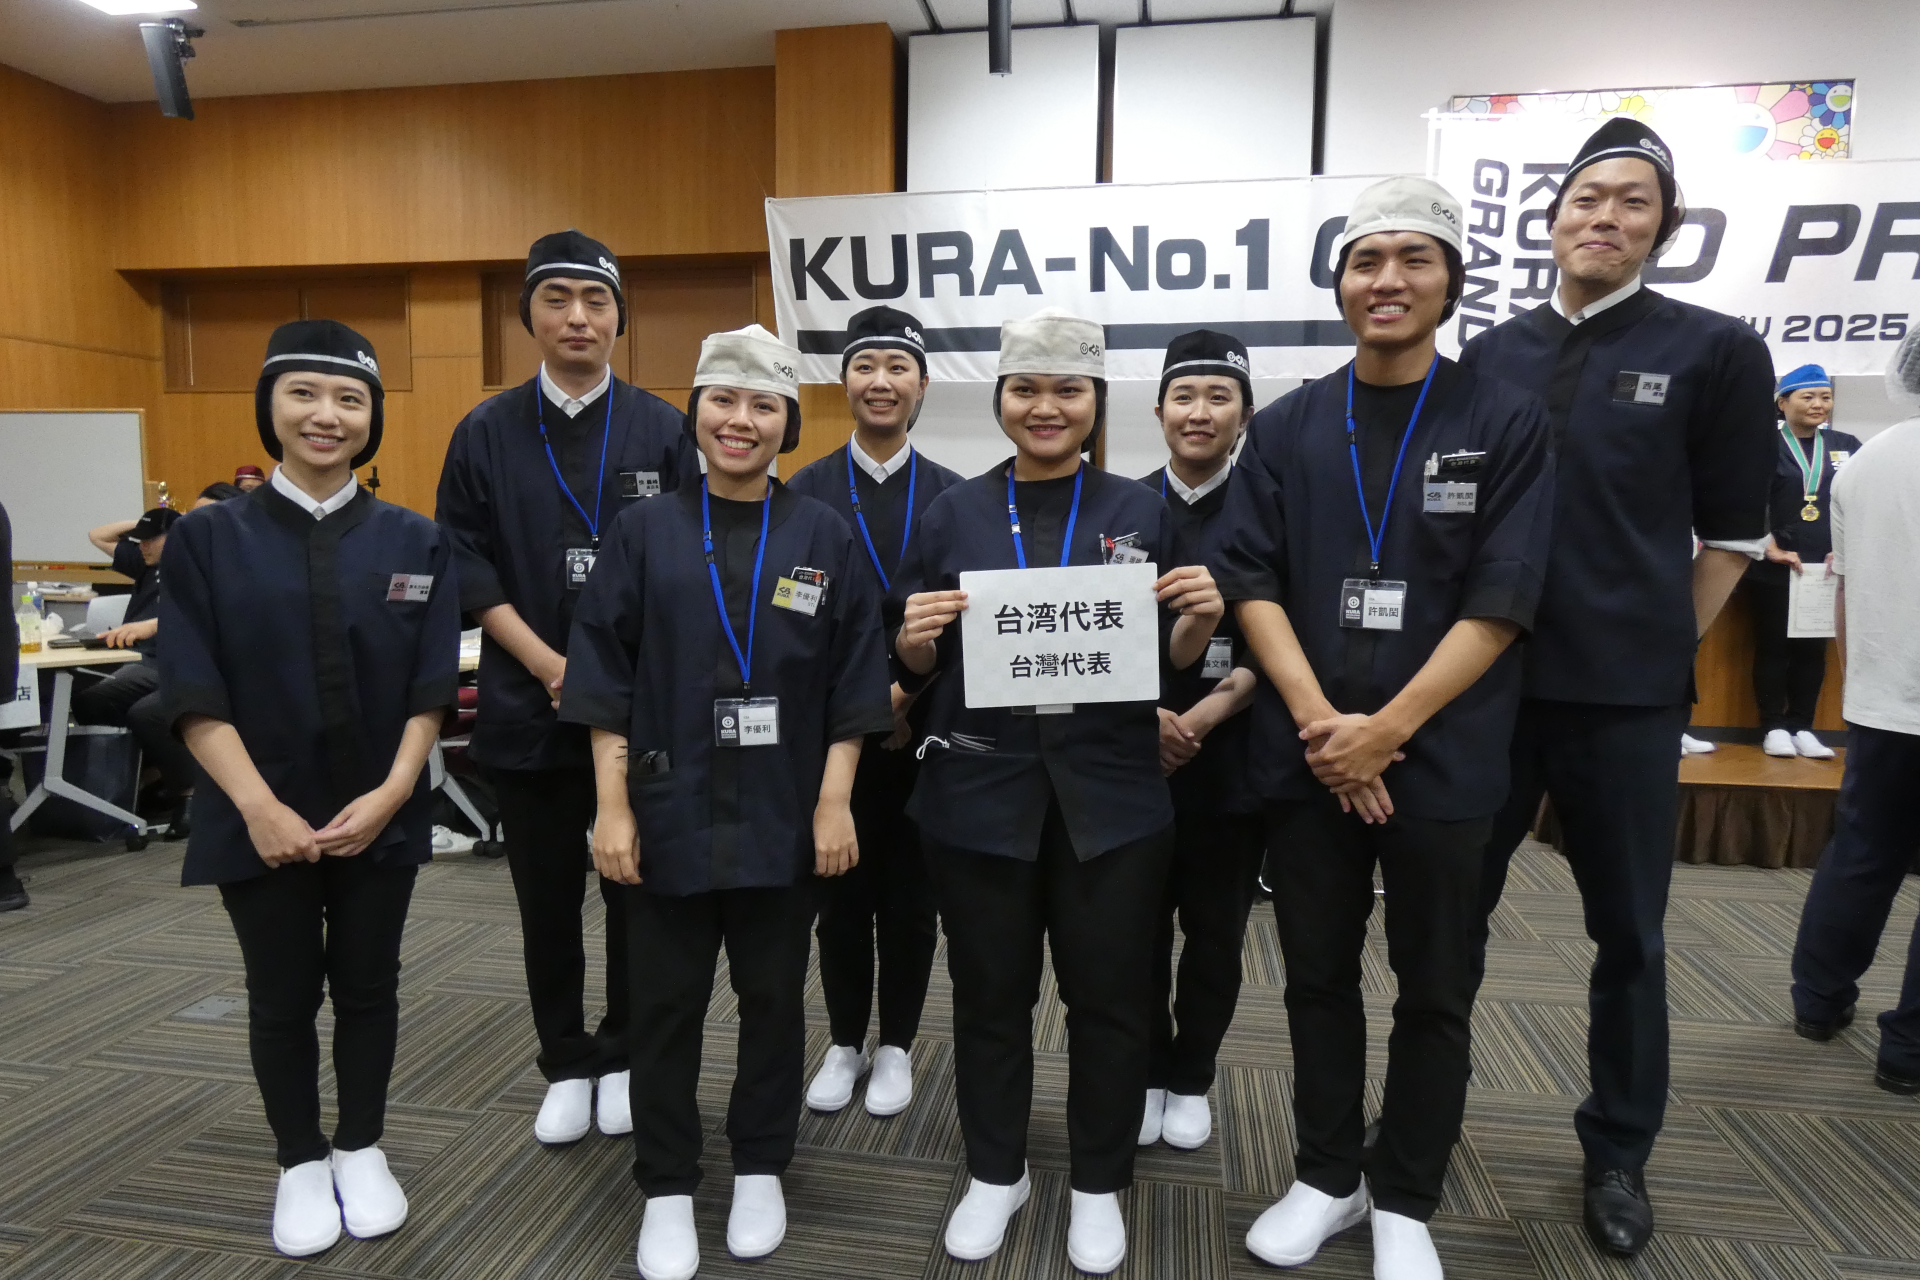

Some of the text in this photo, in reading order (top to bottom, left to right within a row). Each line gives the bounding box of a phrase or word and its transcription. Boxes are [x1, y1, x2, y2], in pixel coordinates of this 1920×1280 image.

[1508, 162, 1570, 318] KUR
[789, 217, 1270, 302] KURA-No.1
[1781, 313, 1909, 342] 2025
[994, 599, 1124, 636] 台湾代表
[1009, 651, 1112, 679] 台灣代表
